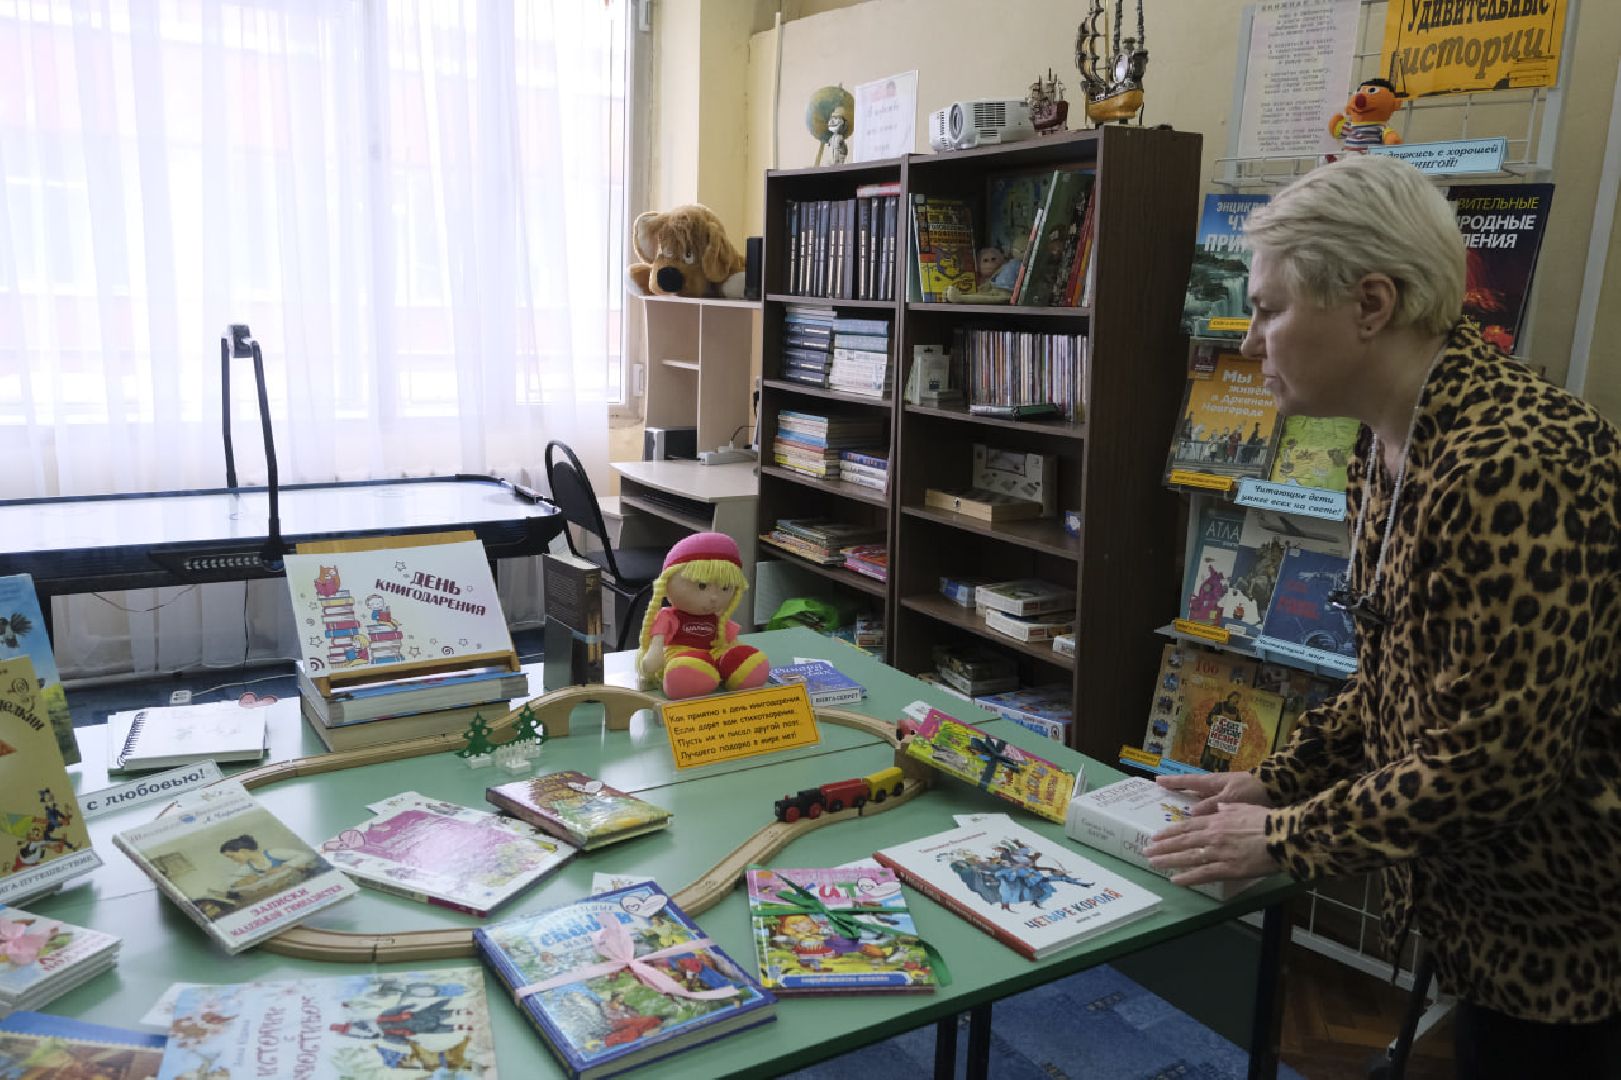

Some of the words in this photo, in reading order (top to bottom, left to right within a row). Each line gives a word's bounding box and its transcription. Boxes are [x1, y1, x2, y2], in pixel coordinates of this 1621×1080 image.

[1402, 26, 1546, 79] истории
[1457, 196, 1540, 209] ВИТЕЛЬНЫЕ
[1458, 214, 1537, 232] РОДНЫЕ
[1223, 370, 1252, 384] Мы
[1205, 520, 1240, 541] АТЛА
[410, 571, 461, 596] ДЕНЬ
[376, 578, 486, 616] КНИГОДАРЕНИЯ
[687, 710, 720, 720] приятно
[673, 727, 695, 735] Если
[677, 739, 703, 748] Пусть
[754, 722, 781, 734] другой
[86, 801, 98, 811] с
[105, 768, 206, 807] любовью!
[251, 887, 310, 916] ЗАПИСКИ
[1024, 906, 1077, 929] ЧЕТЫРЕ
[1071, 887, 1123, 912] КОРОЛЯ
